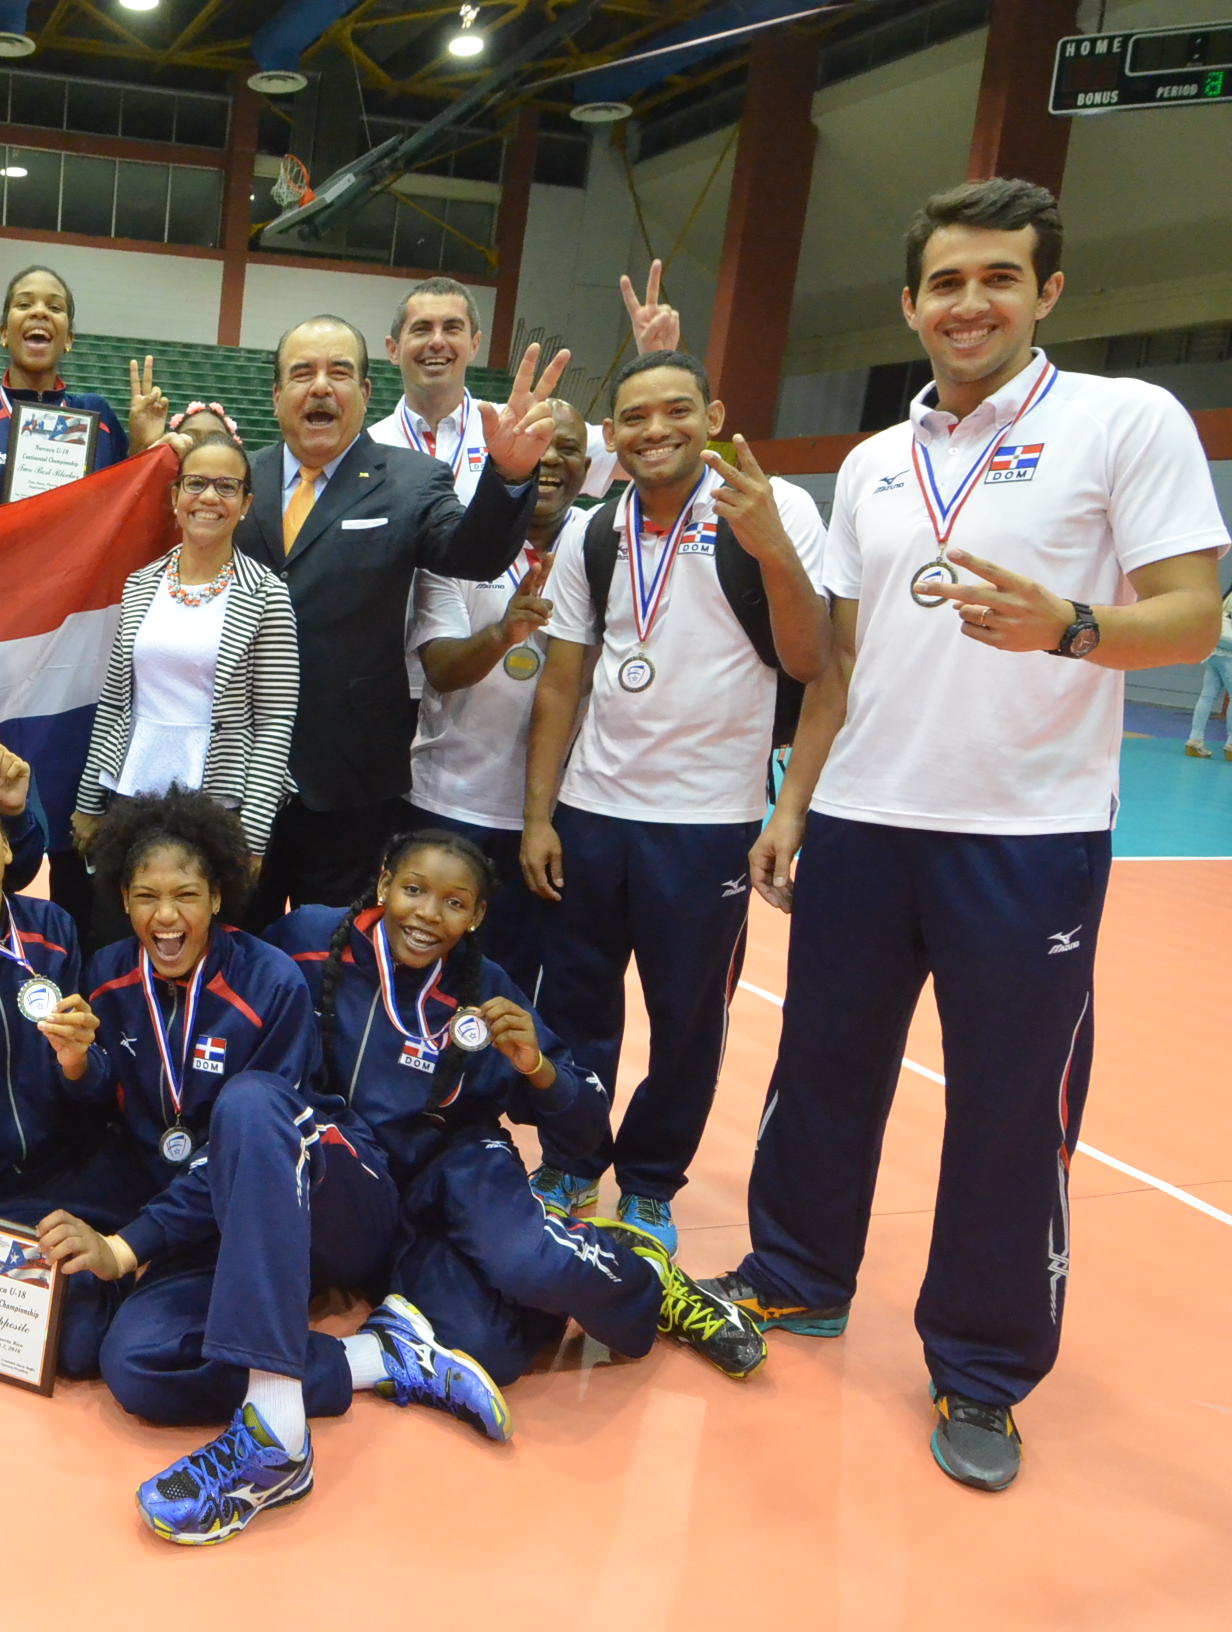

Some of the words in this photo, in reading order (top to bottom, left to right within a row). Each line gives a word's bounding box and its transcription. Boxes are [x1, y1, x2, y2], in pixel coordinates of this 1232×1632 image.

[1065, 37, 1124, 57] HOME
[1076, 90, 1119, 106] BONUS
[1155, 84, 1198, 99] PERIOD
[993, 470, 1027, 481] DOM
[682, 544, 709, 553] DOM
[196, 1059, 219, 1071] DOM
[405, 1056, 430, 1071] DOM
[9, 1287, 27, 1299] U-18
